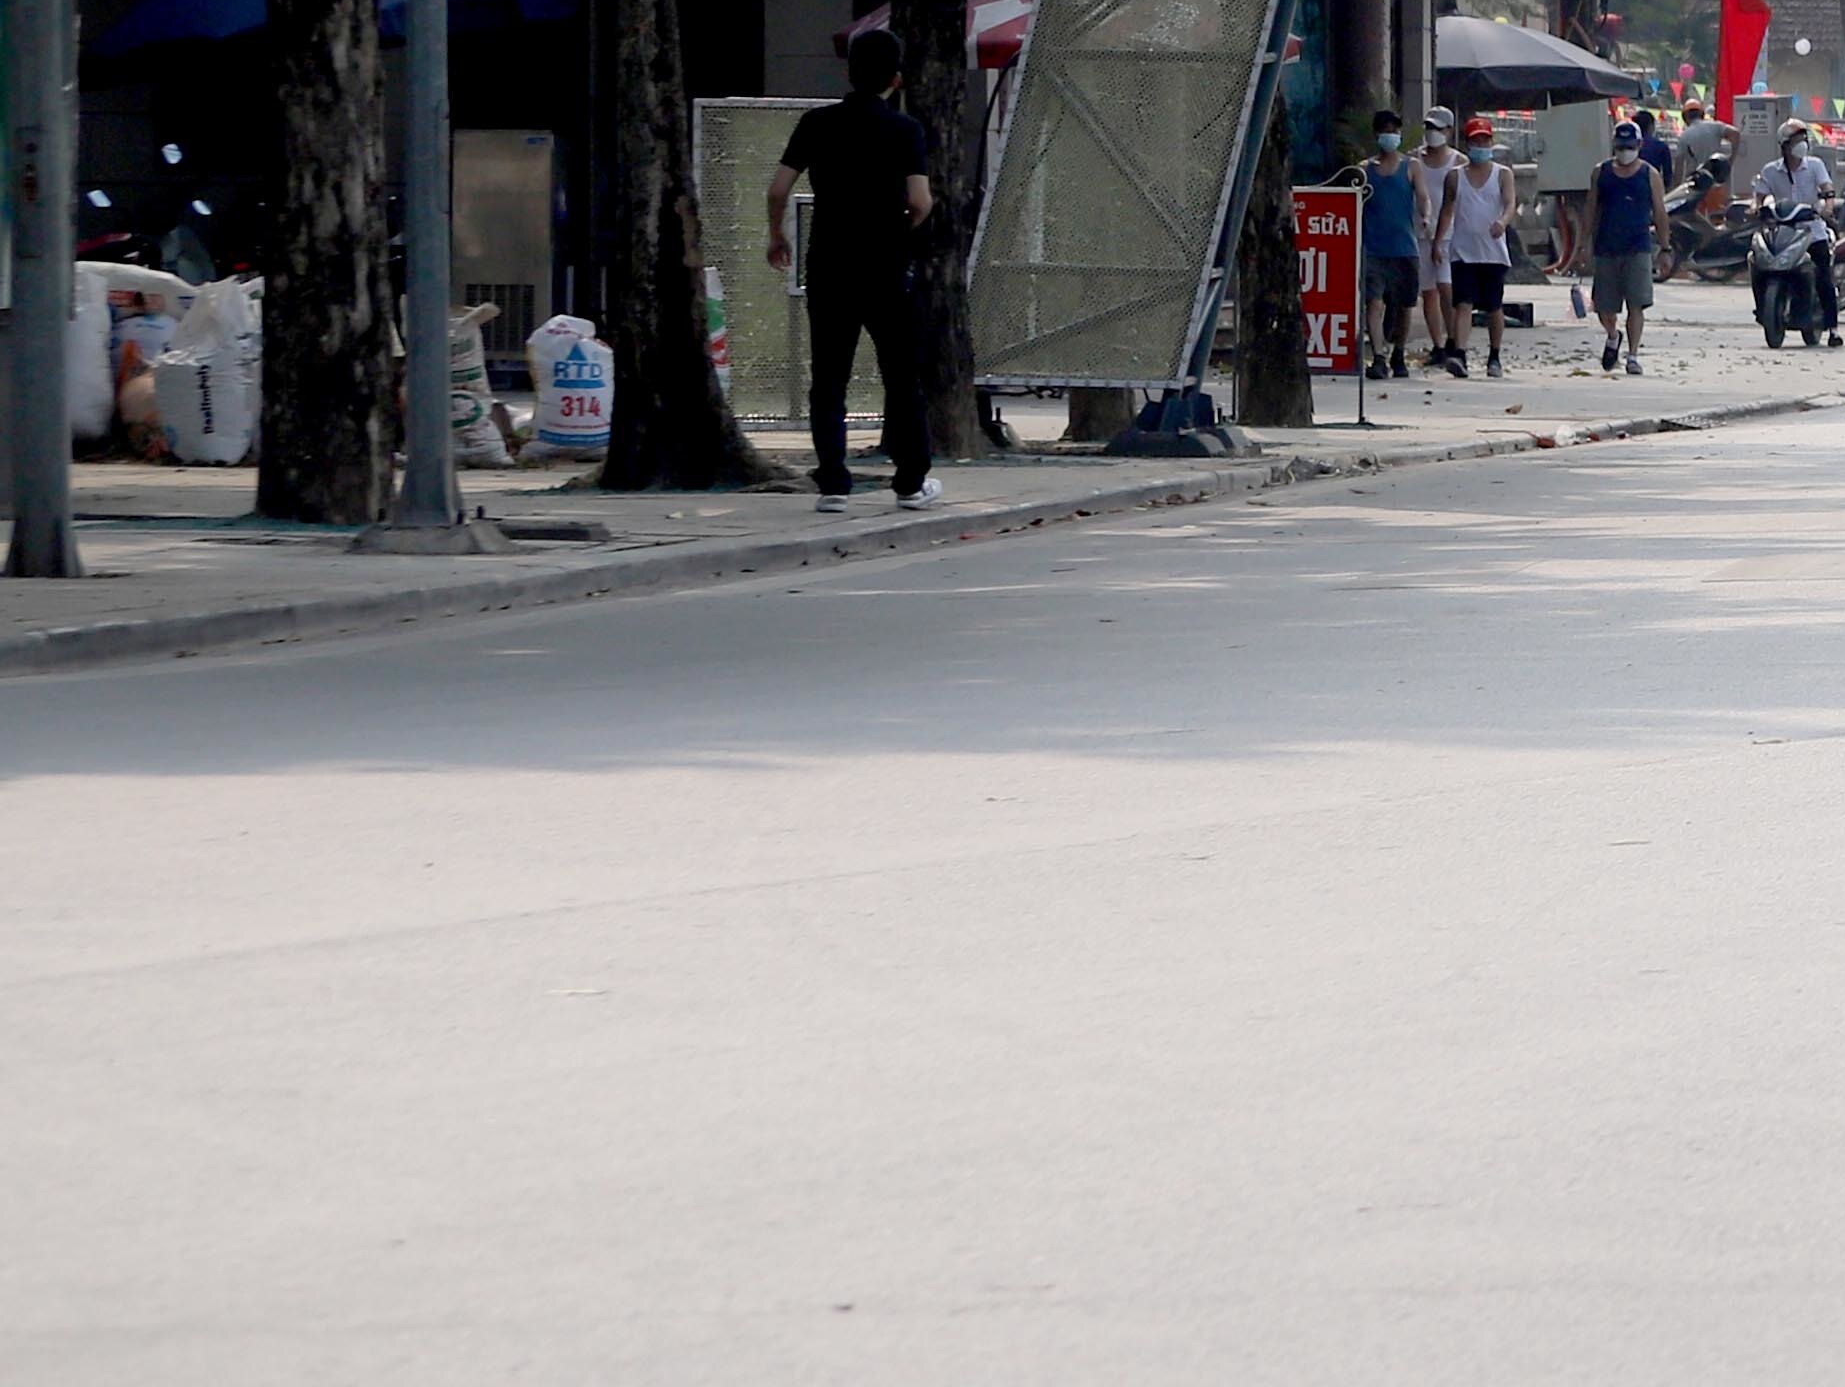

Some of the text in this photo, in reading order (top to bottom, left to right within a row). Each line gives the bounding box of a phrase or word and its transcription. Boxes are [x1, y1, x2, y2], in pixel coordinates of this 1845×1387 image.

[1306, 313, 1348, 355] XE
[553, 362, 603, 378] RTD
[560, 395, 601, 417] 314
